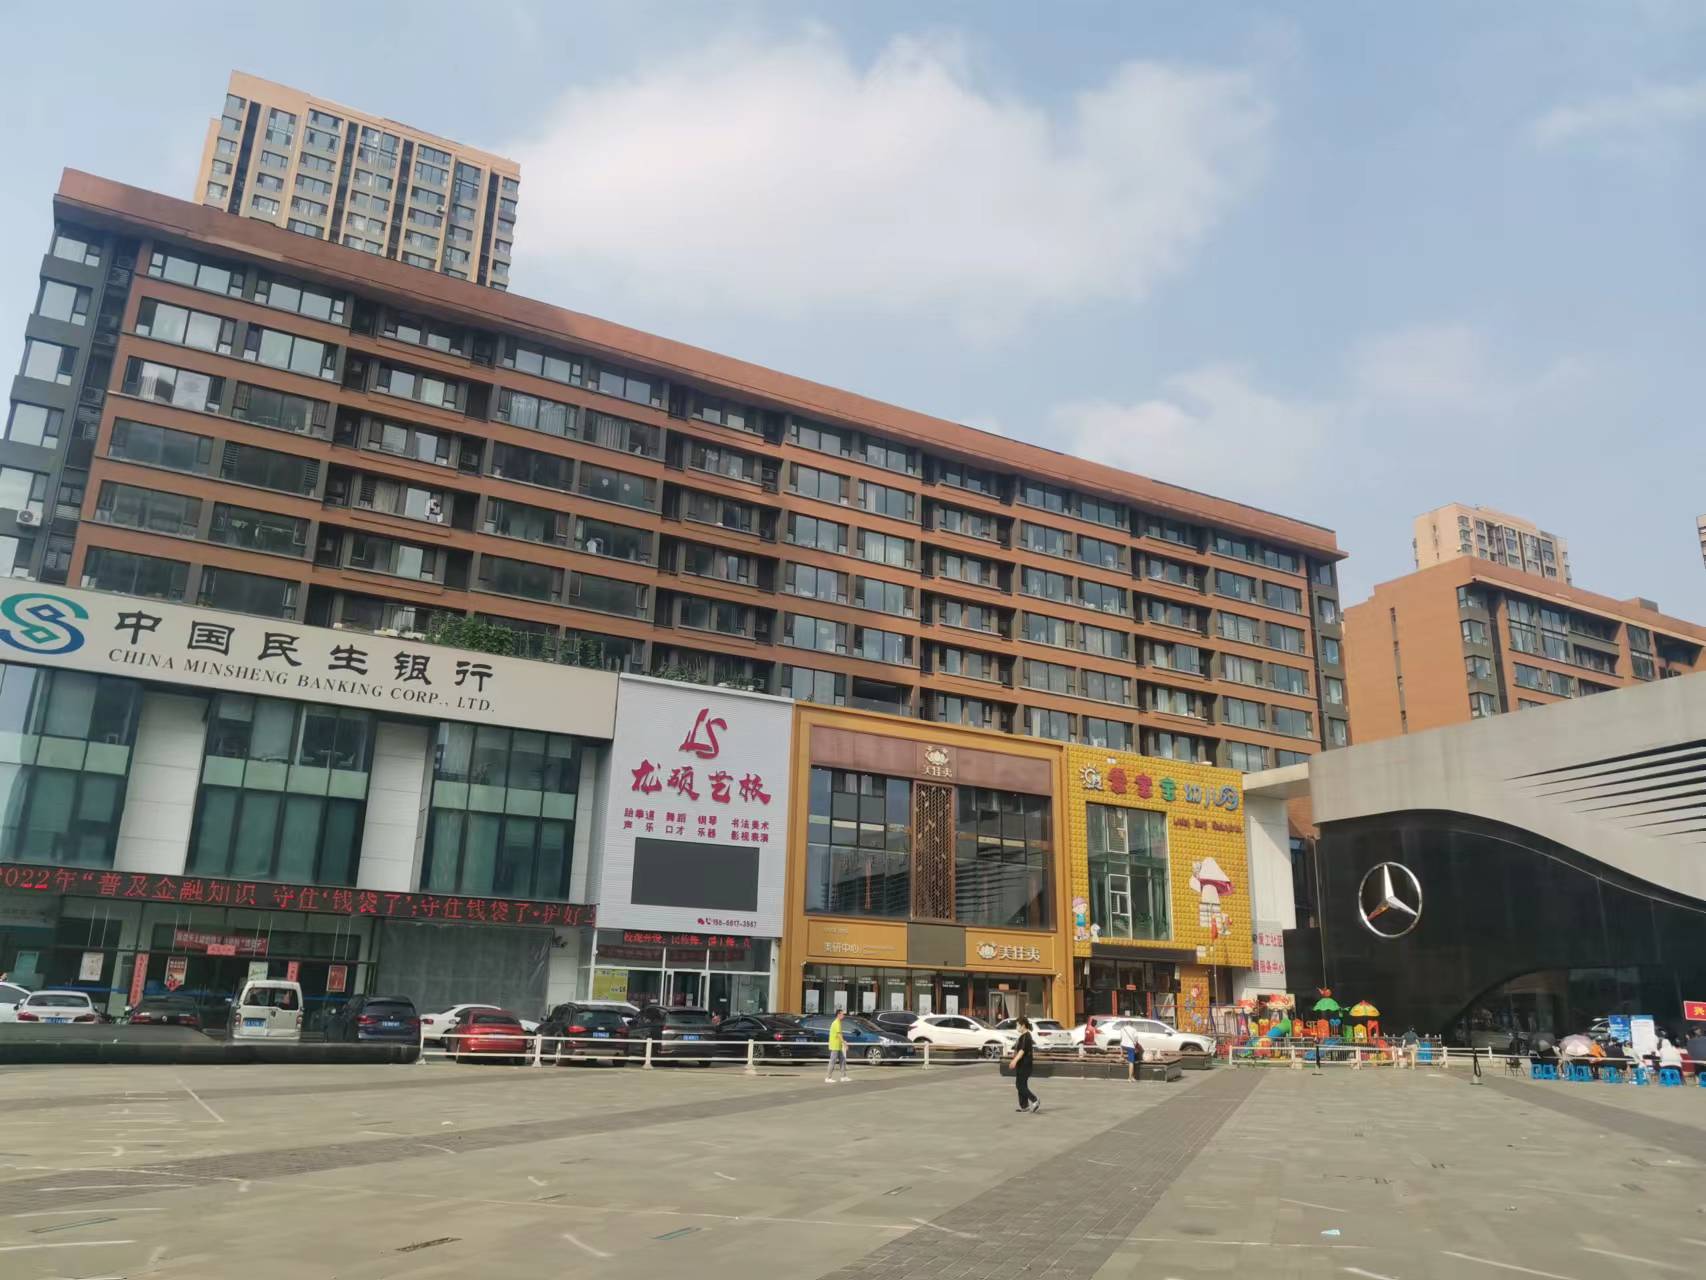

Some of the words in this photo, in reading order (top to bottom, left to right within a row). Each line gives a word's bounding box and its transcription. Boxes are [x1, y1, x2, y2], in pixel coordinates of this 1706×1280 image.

[114, 610, 493, 692] 中国民生银行
[108, 648, 174, 670] CHINA
[183, 658, 288, 686] MINSHENG
[297, 674, 383, 698] BANKING
[457, 695, 495, 713] LTD.
[631, 759, 772, 806] 龙硕艺校
[624, 807, 655, 821] 跆拳道
[666, 811, 687, 824] 舞蹈
[697, 815, 718, 826] 钢琴
[731, 818, 770, 831] 书法美术
[665, 825, 685, 836] 口才
[697, 827, 716, 839] 乐器
[730, 830, 769, 843] 影视表演
[0, 867, 256, 906] 022年“普及金融知识
